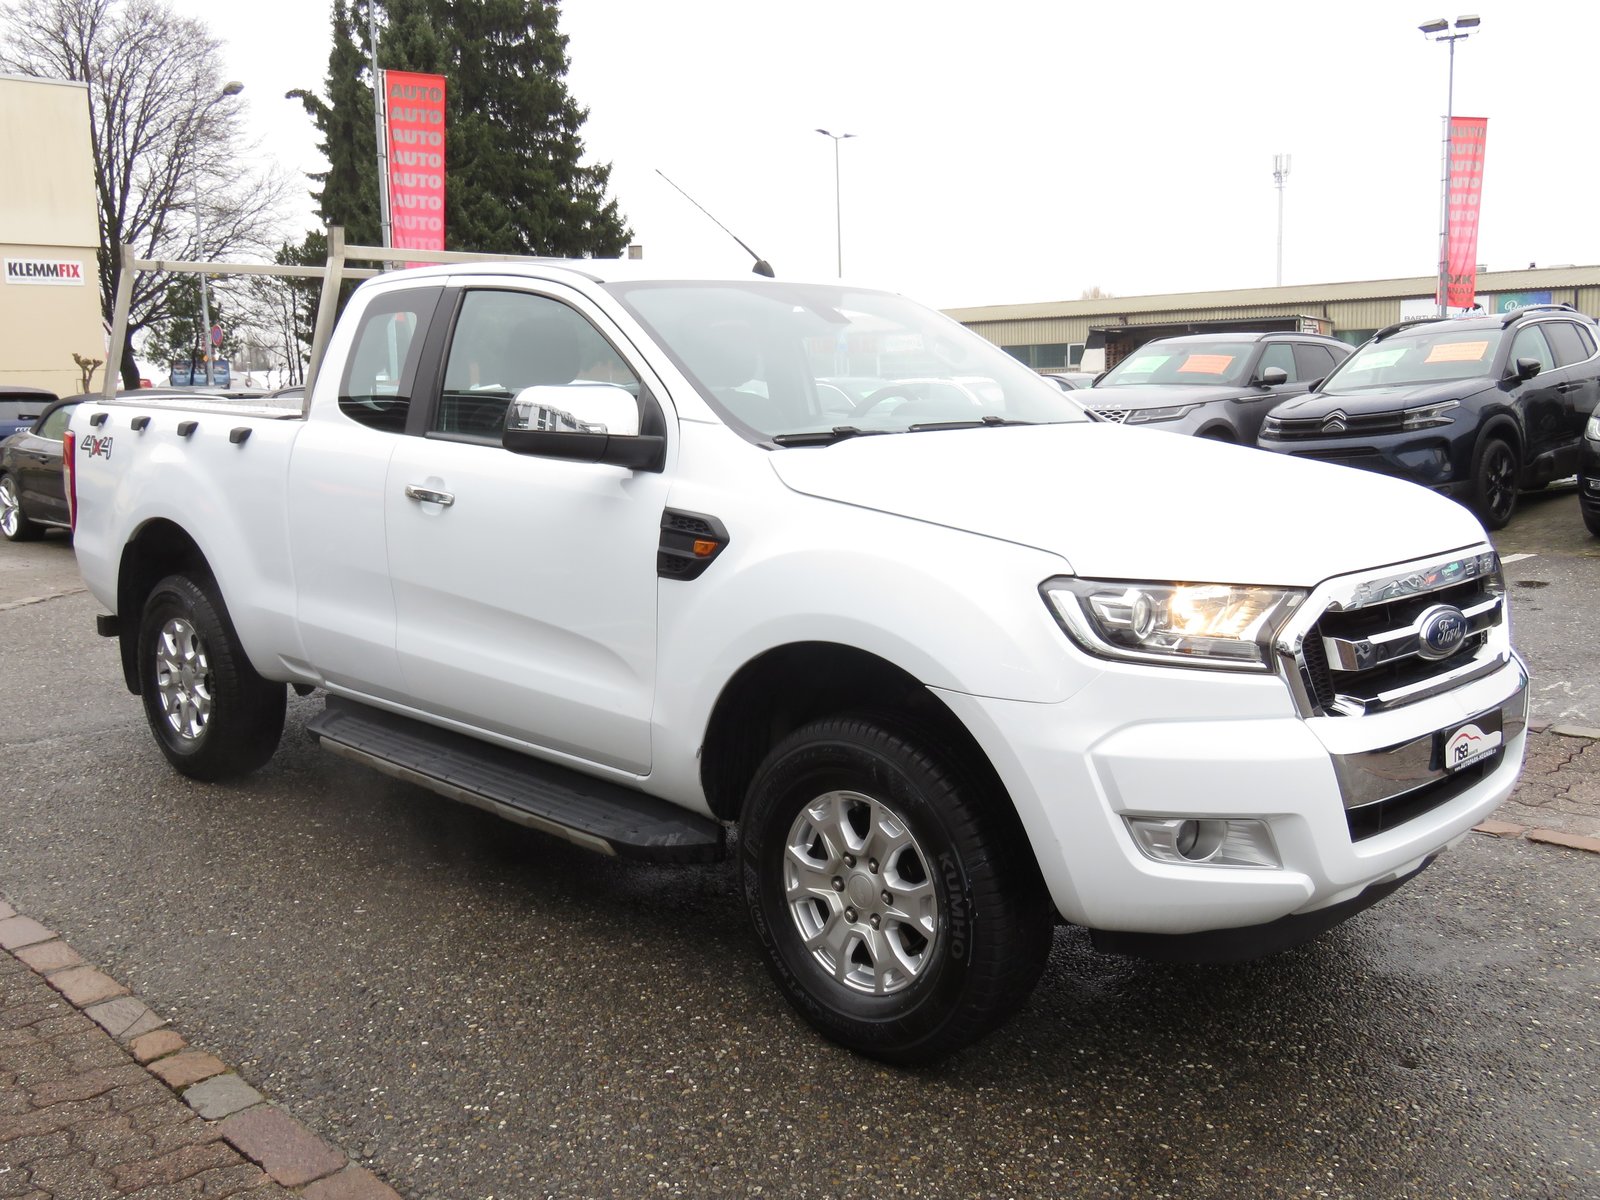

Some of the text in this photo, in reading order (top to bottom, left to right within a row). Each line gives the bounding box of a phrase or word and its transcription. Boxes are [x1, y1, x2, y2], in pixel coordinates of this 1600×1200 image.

[391, 83, 442, 103] AUTO
[391, 106, 442, 124] AUTO
[392, 129, 442, 146] AUTO
[392, 151, 442, 168] AUTO
[392, 172, 442, 189] AUTO
[393, 194, 442, 209] AUTO
[393, 216, 442, 231] AUTO
[8, 262, 80, 278] KLEMMFIX
[1437, 618, 1462, 645] Ford
[940, 852, 965, 959] KUMHO
